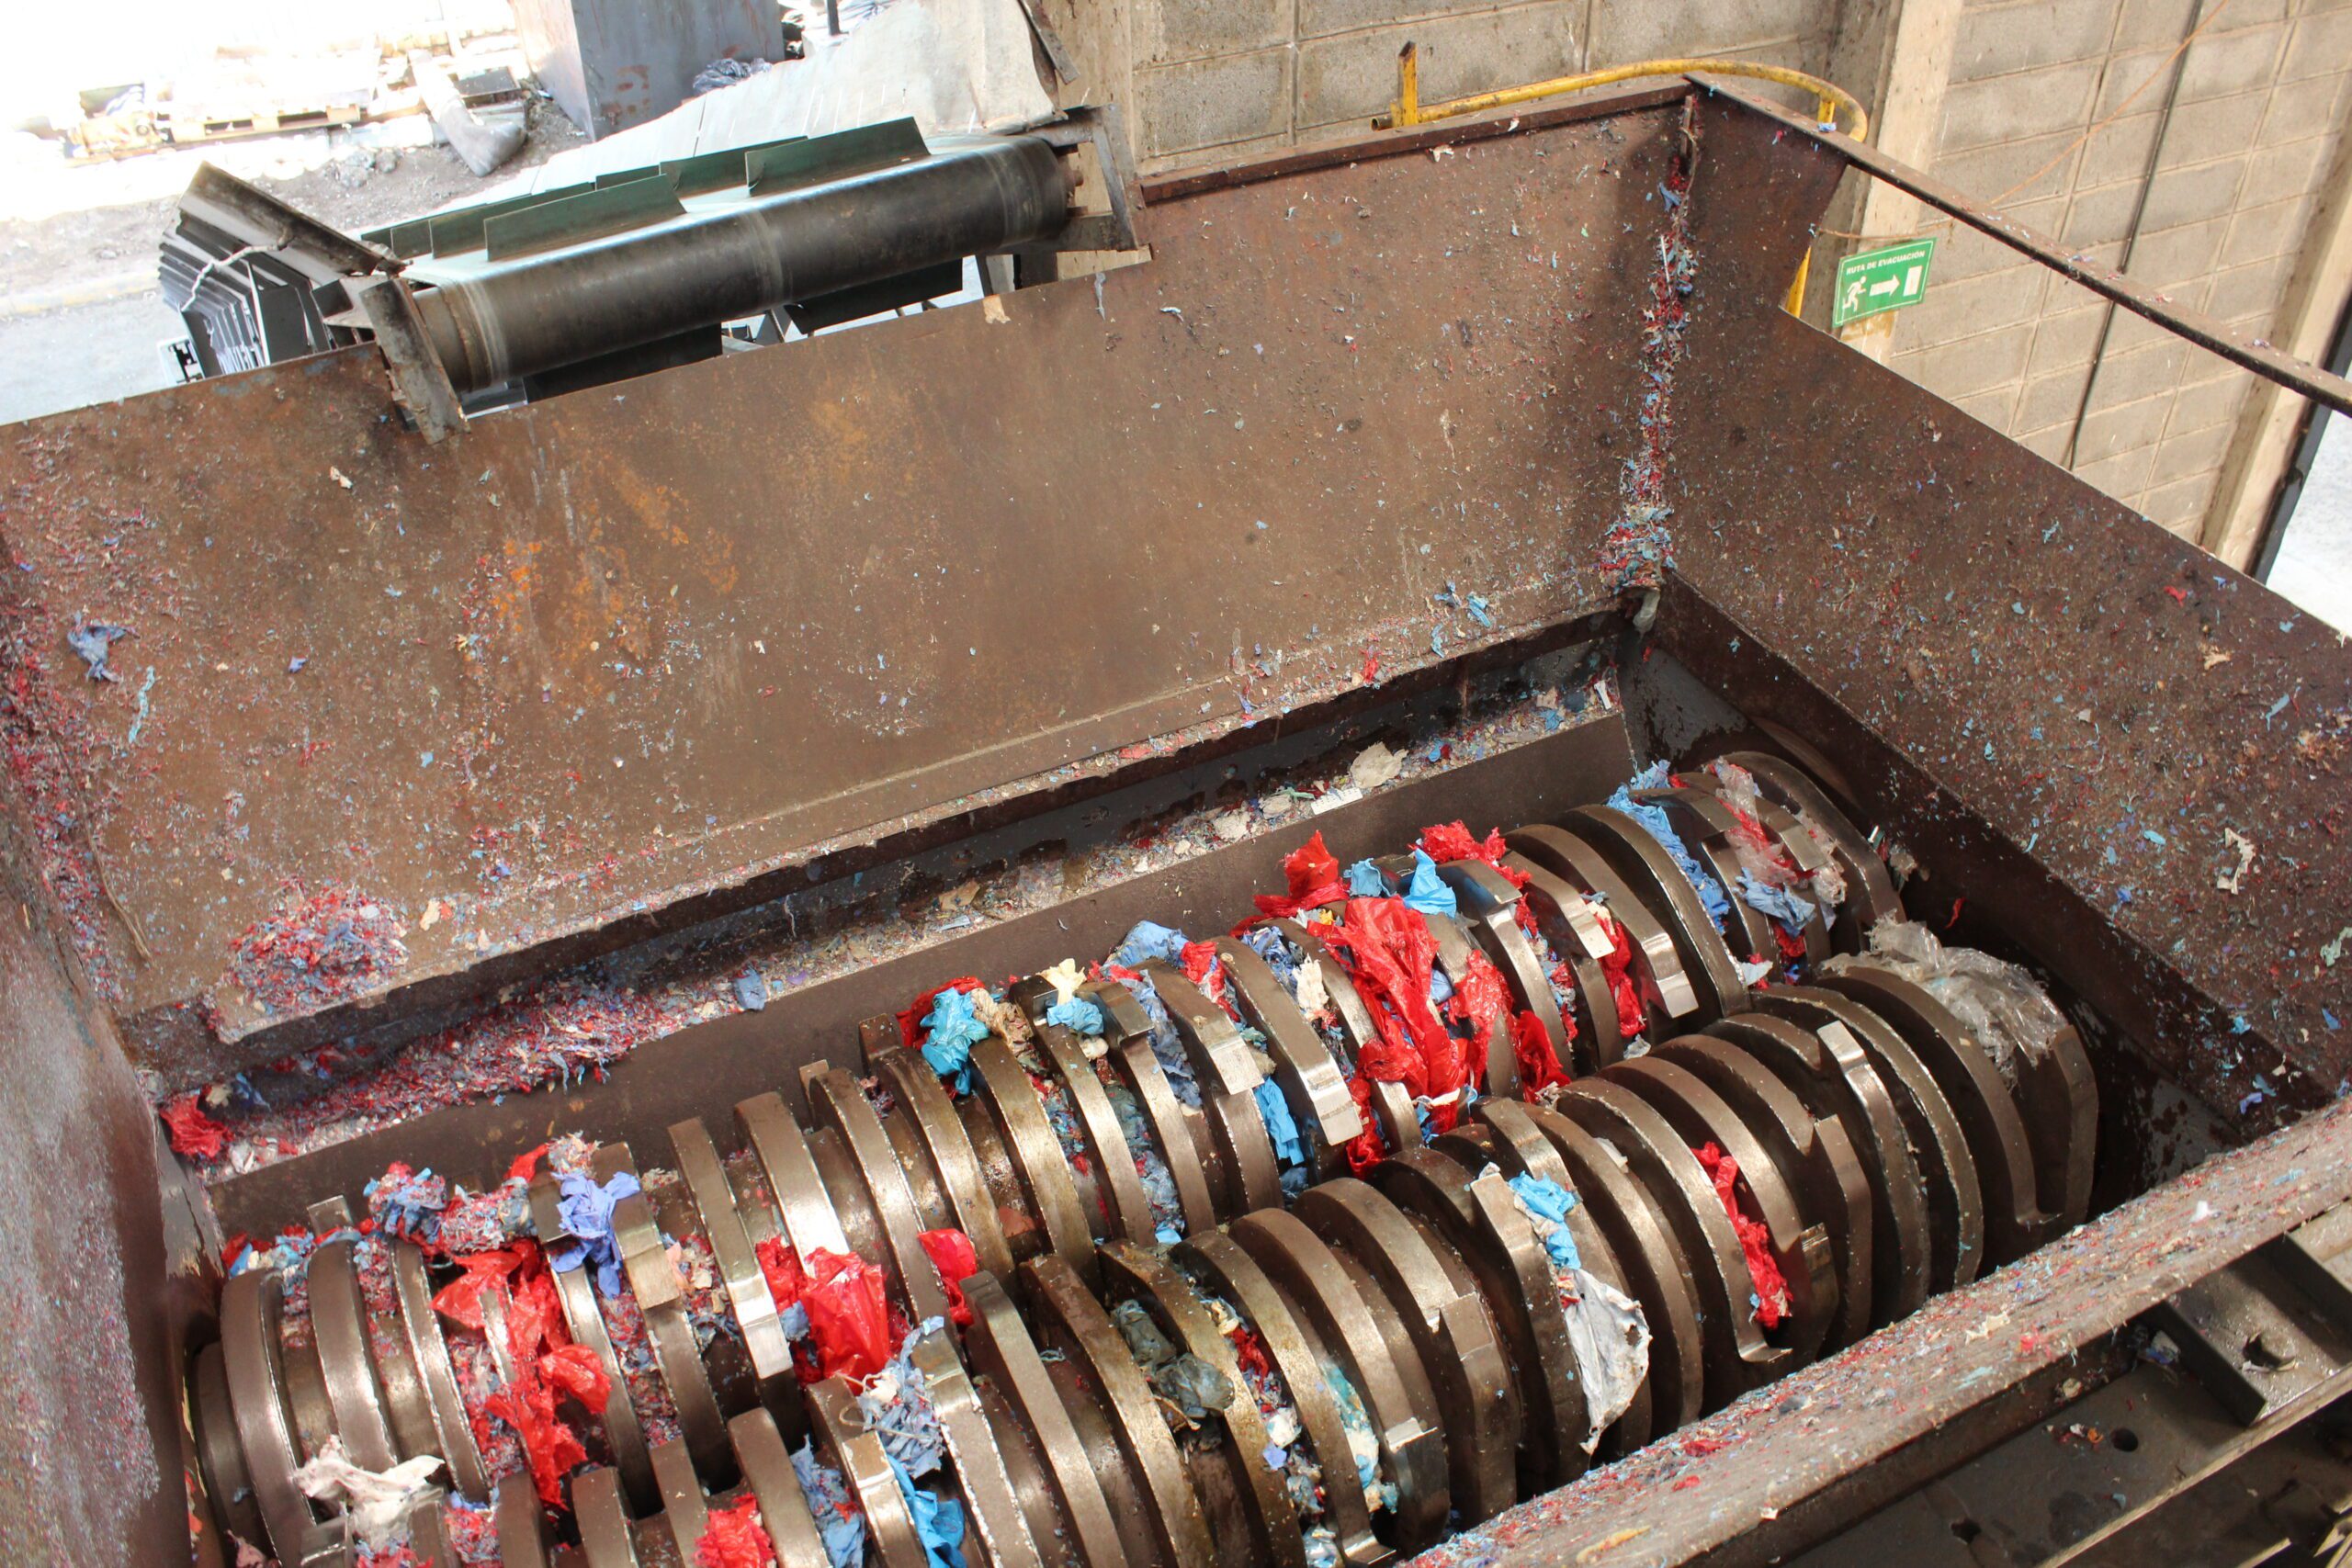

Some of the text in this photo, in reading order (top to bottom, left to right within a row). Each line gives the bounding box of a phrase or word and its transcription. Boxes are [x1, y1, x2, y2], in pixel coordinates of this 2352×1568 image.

[1846, 250, 1926, 276] RUTA DE EVACUACIÓN
